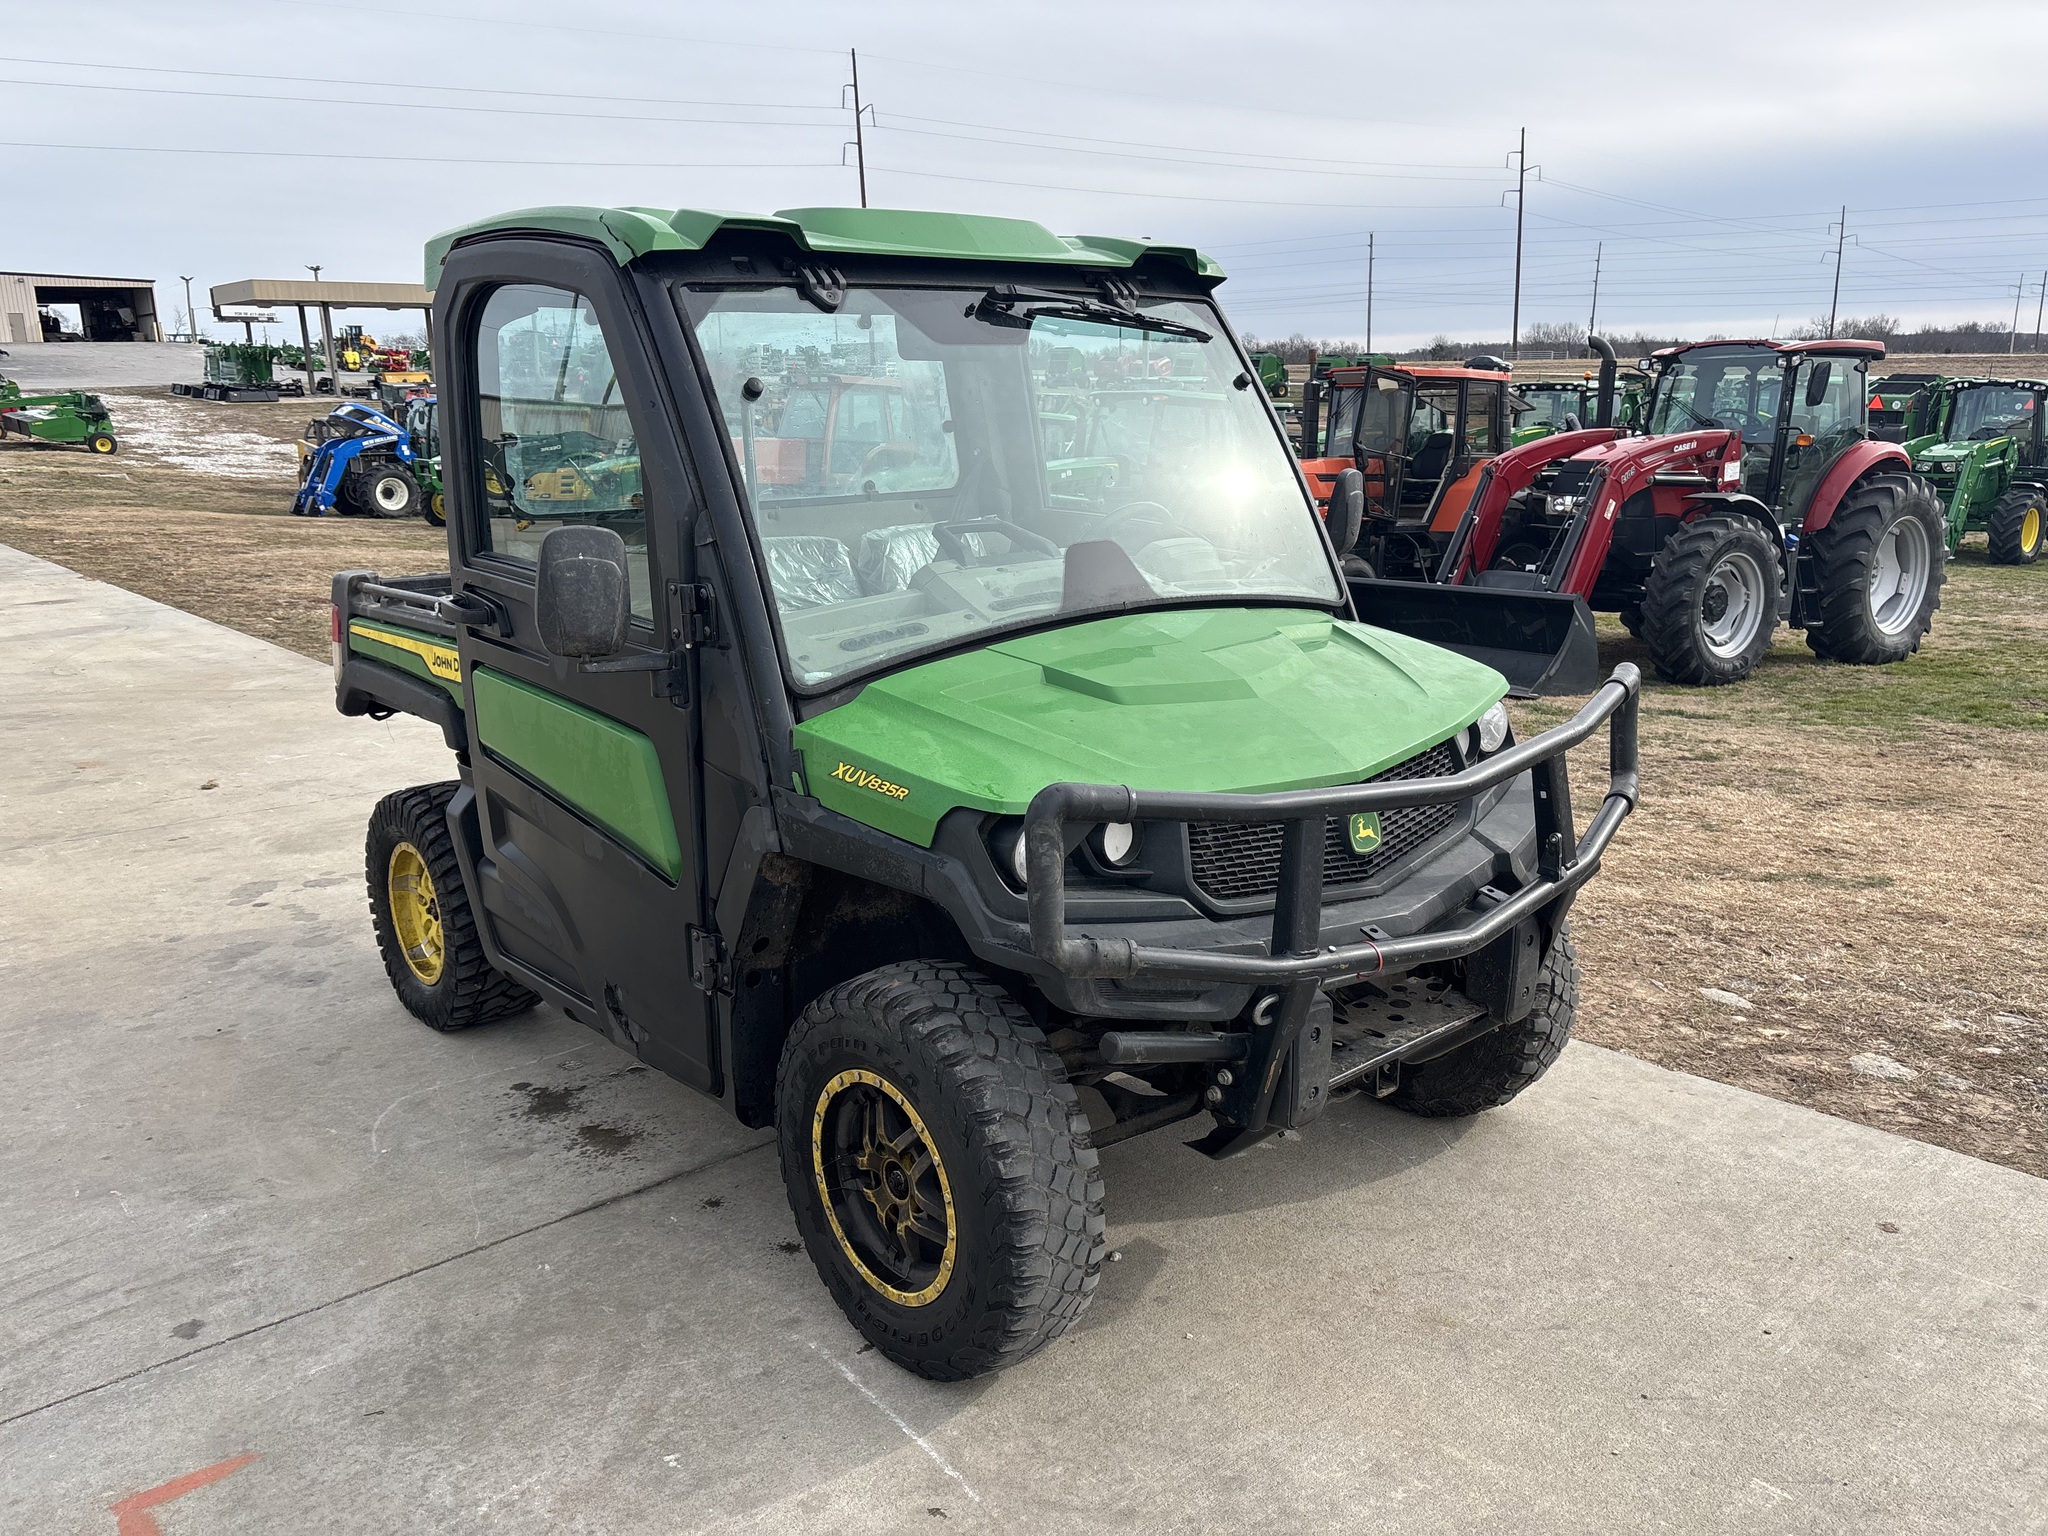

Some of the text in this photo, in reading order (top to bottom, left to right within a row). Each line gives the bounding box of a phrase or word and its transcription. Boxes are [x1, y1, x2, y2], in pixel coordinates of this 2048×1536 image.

[362, 434, 398, 447] NEW HOLLAND
[1673, 442, 1691, 453] CASE
[432, 652, 453, 671] JOHN
[830, 761, 910, 801] XUV835R
